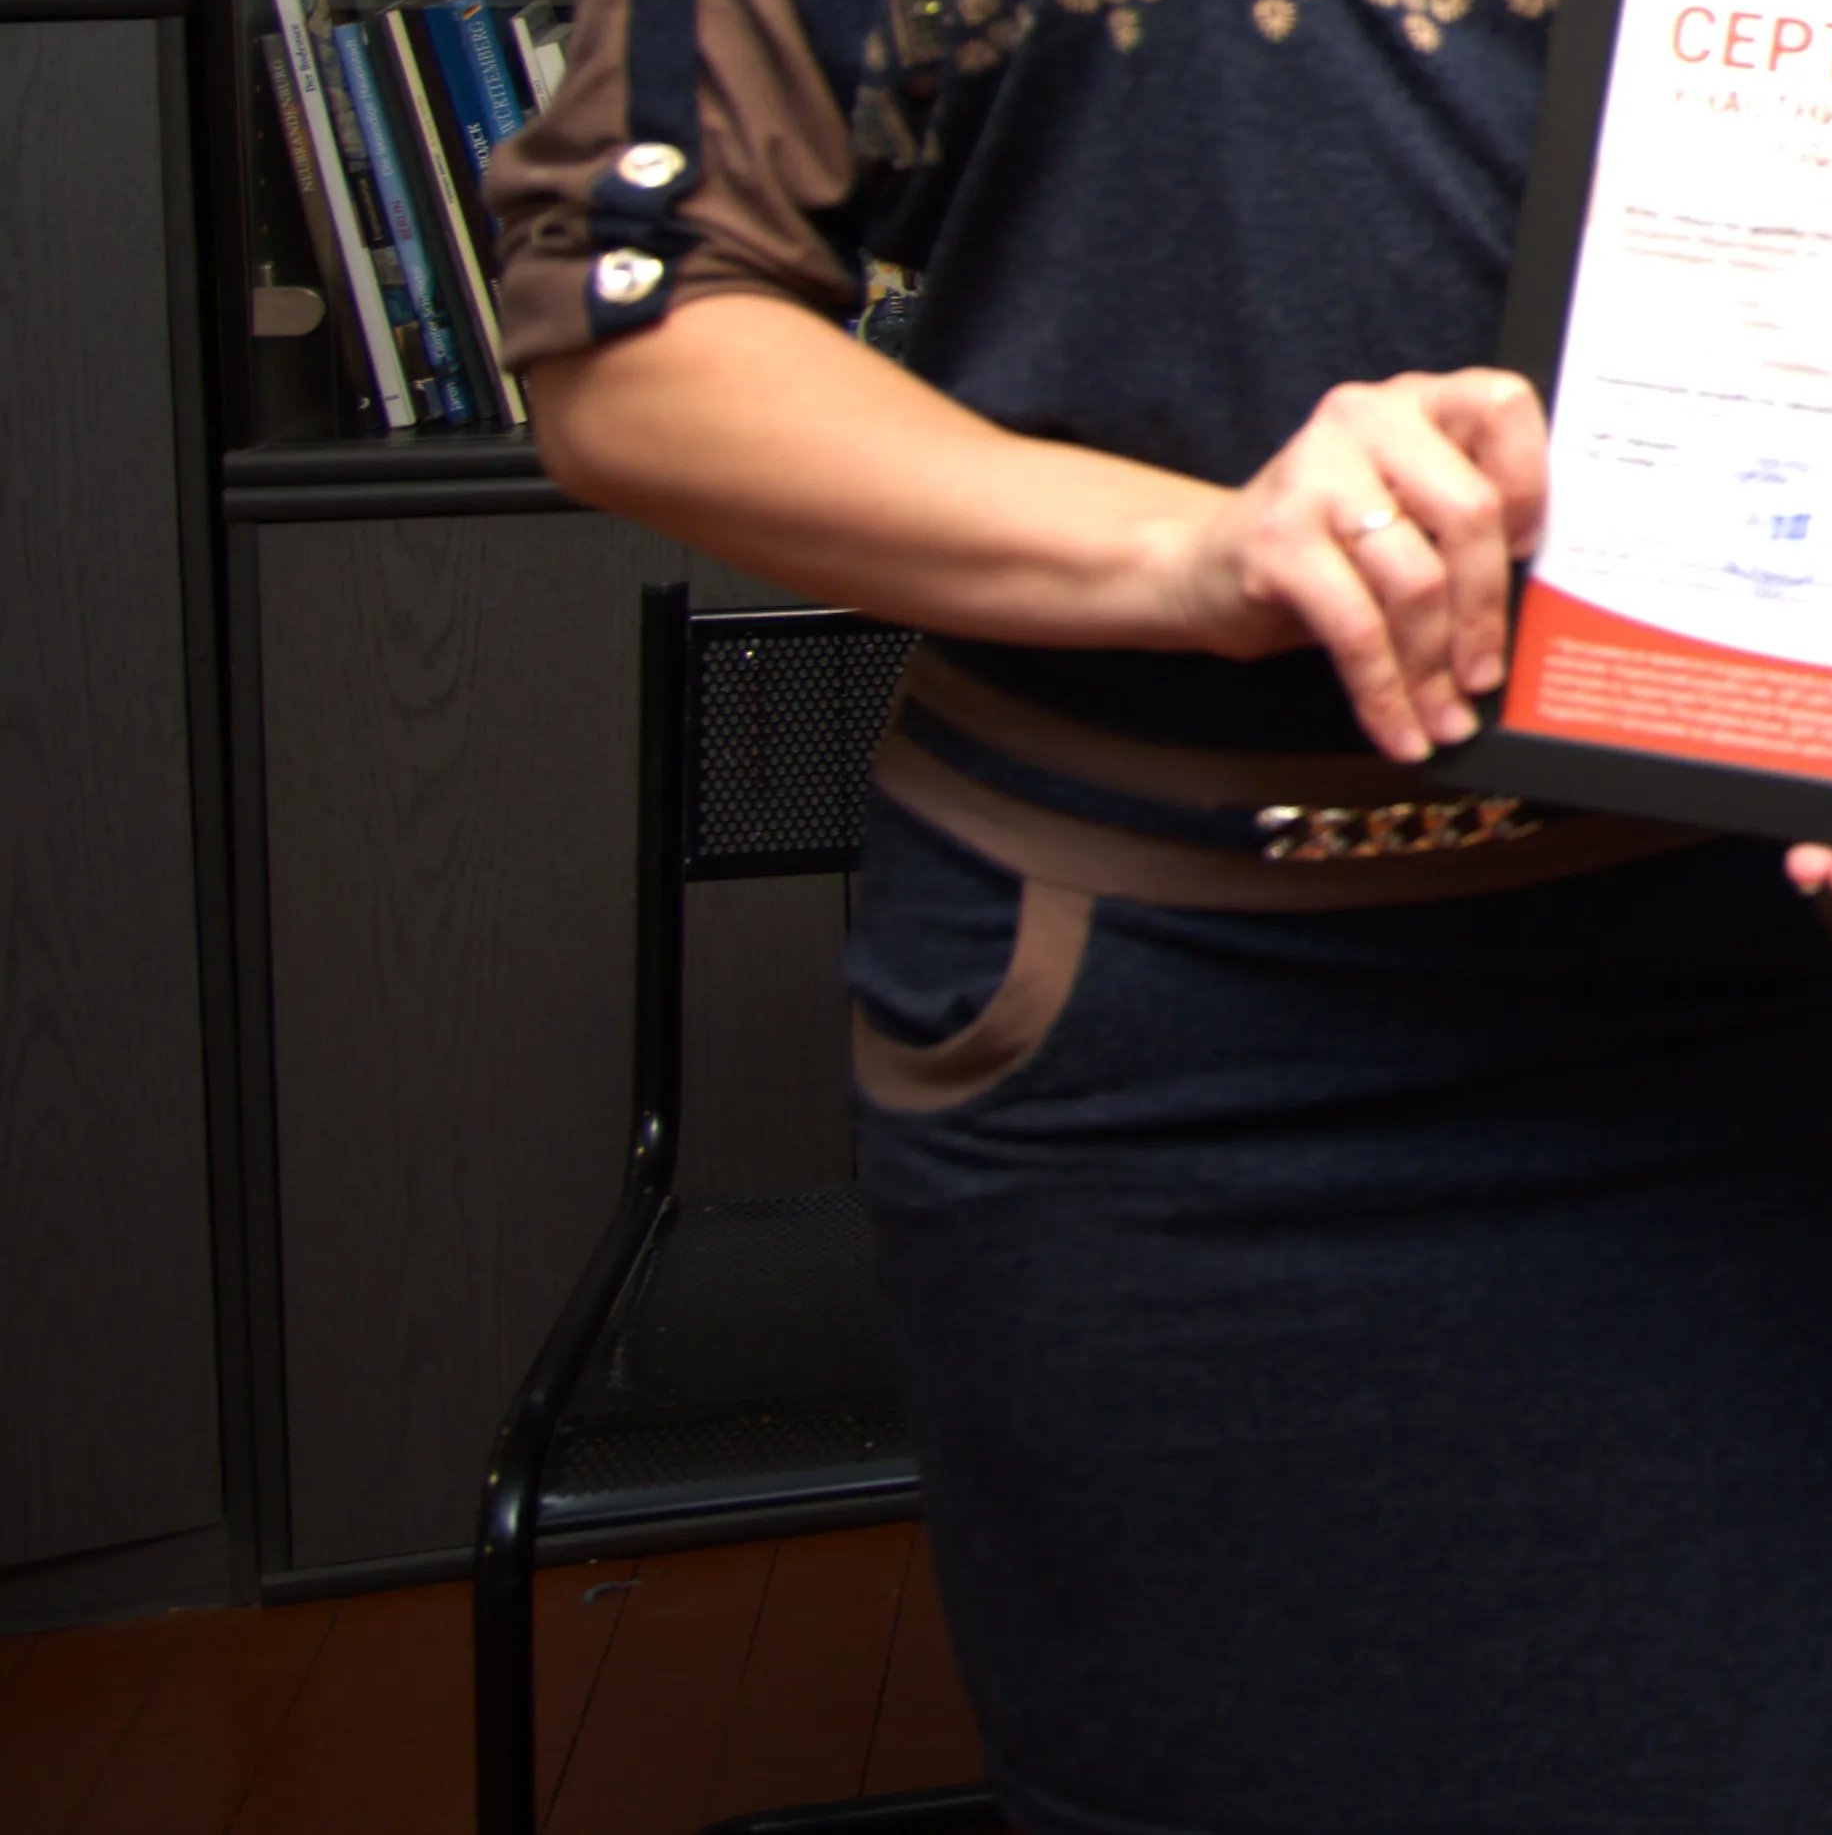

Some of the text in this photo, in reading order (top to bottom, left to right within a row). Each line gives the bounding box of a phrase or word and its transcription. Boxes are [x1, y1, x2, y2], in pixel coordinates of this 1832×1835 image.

[271, 58, 317, 193] NEUBRANDENBURG
[467, 122, 491, 174] ВОДСК
[391, 199, 414, 242] BERLIN
